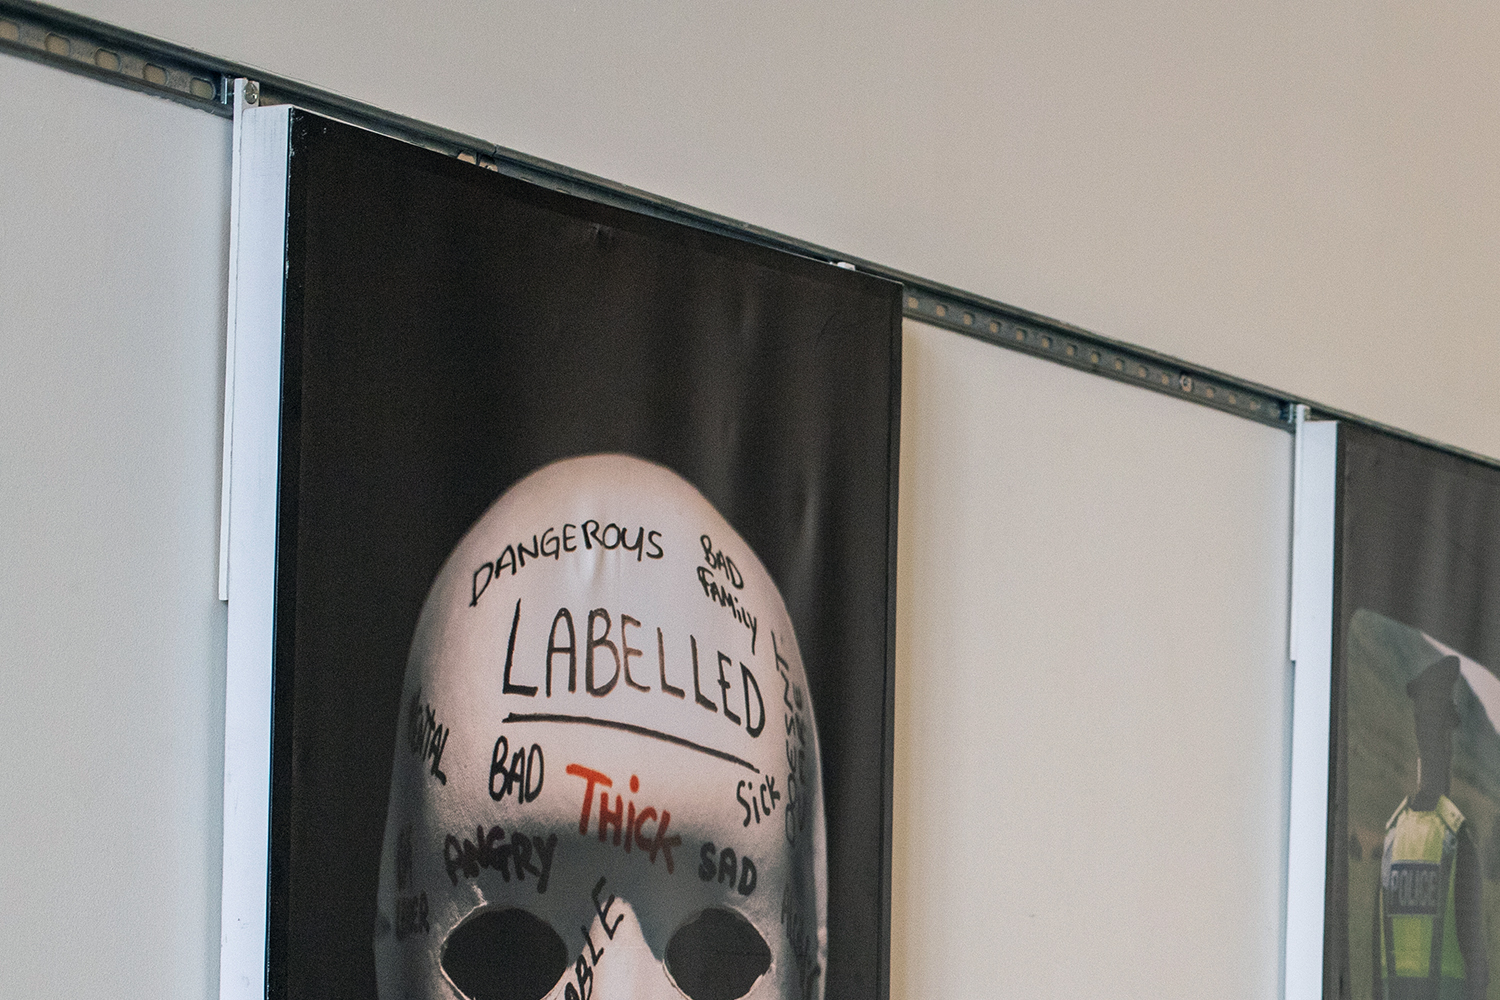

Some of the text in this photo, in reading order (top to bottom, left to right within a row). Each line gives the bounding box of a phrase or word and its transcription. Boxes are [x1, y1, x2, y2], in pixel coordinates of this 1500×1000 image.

[469, 520, 664, 608] DANGEROUS
[699, 533, 745, 590] BAD
[501, 598, 766, 738] LABELLED
[488, 736, 544, 804] BAD
[443, 824, 558, 895] ANGRY
[698, 840, 758, 897] SAD
[1389, 868, 1438, 907] POLICE
